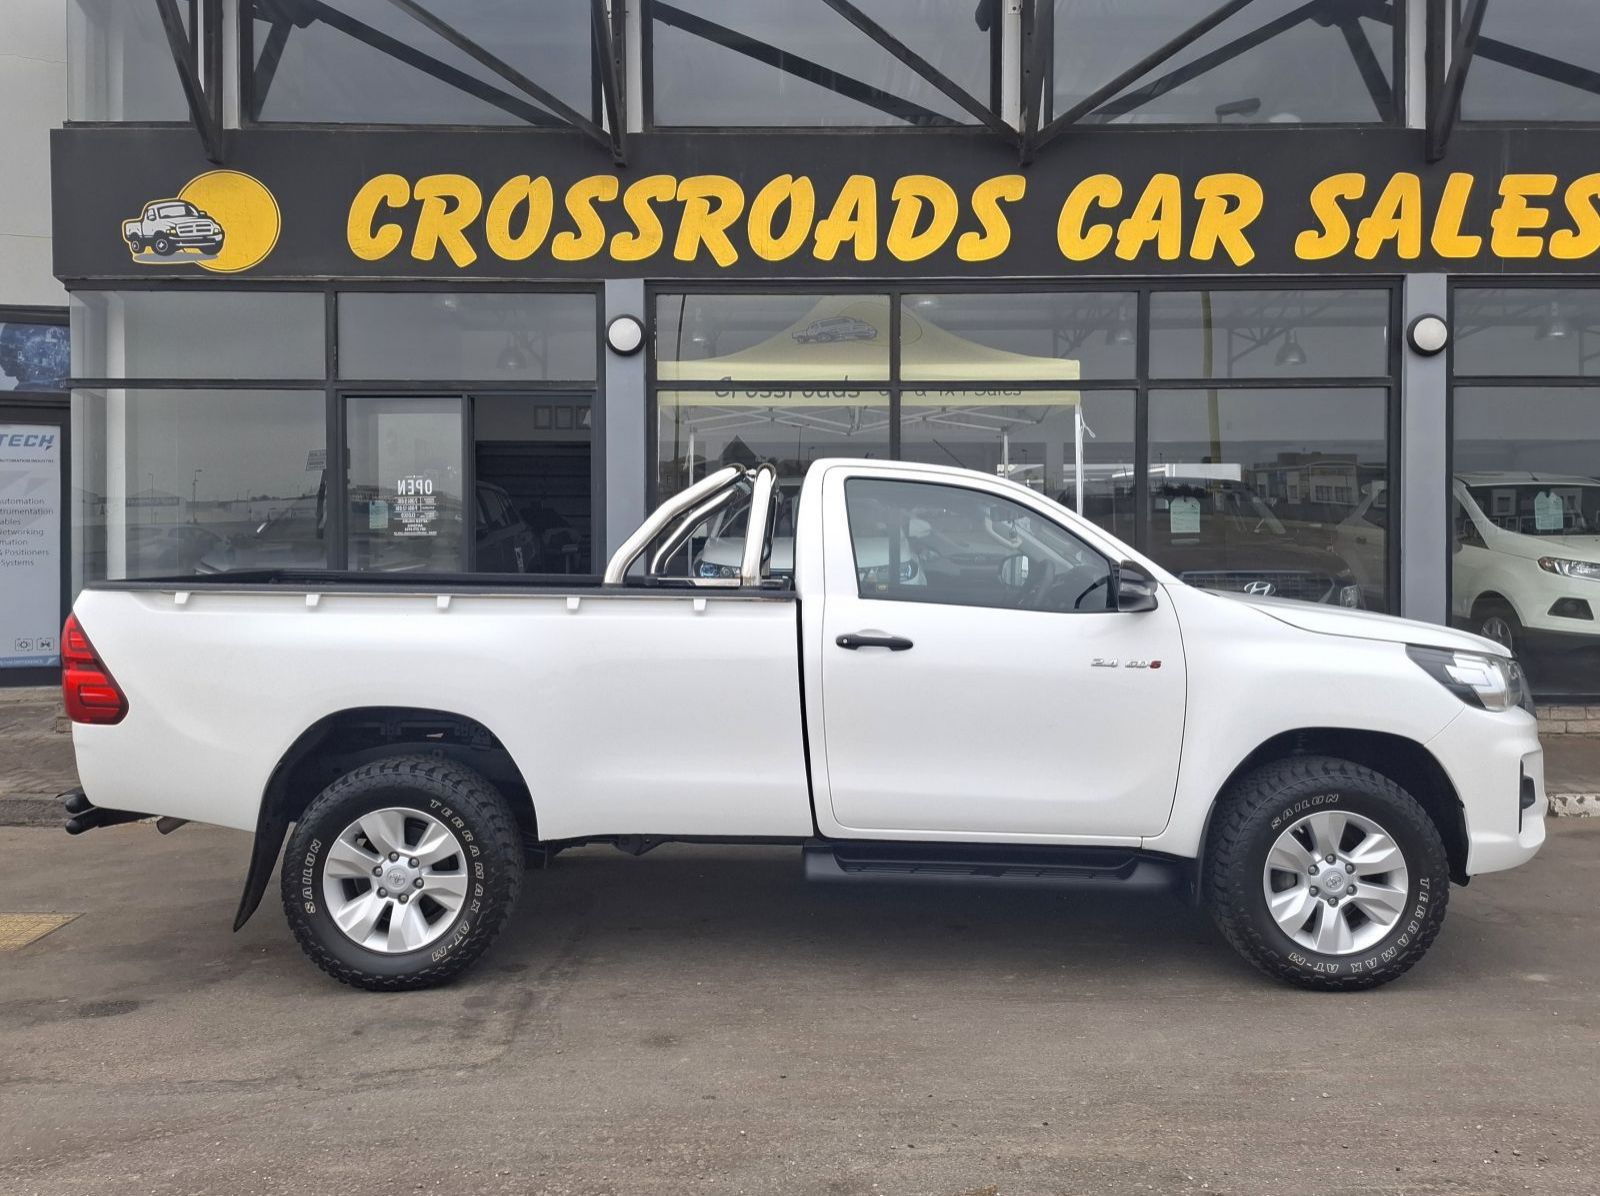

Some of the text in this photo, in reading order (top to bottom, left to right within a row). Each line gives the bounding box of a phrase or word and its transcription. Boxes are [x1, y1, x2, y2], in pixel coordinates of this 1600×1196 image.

[347, 172, 1600, 267] CROSSROADS CAR SALES
